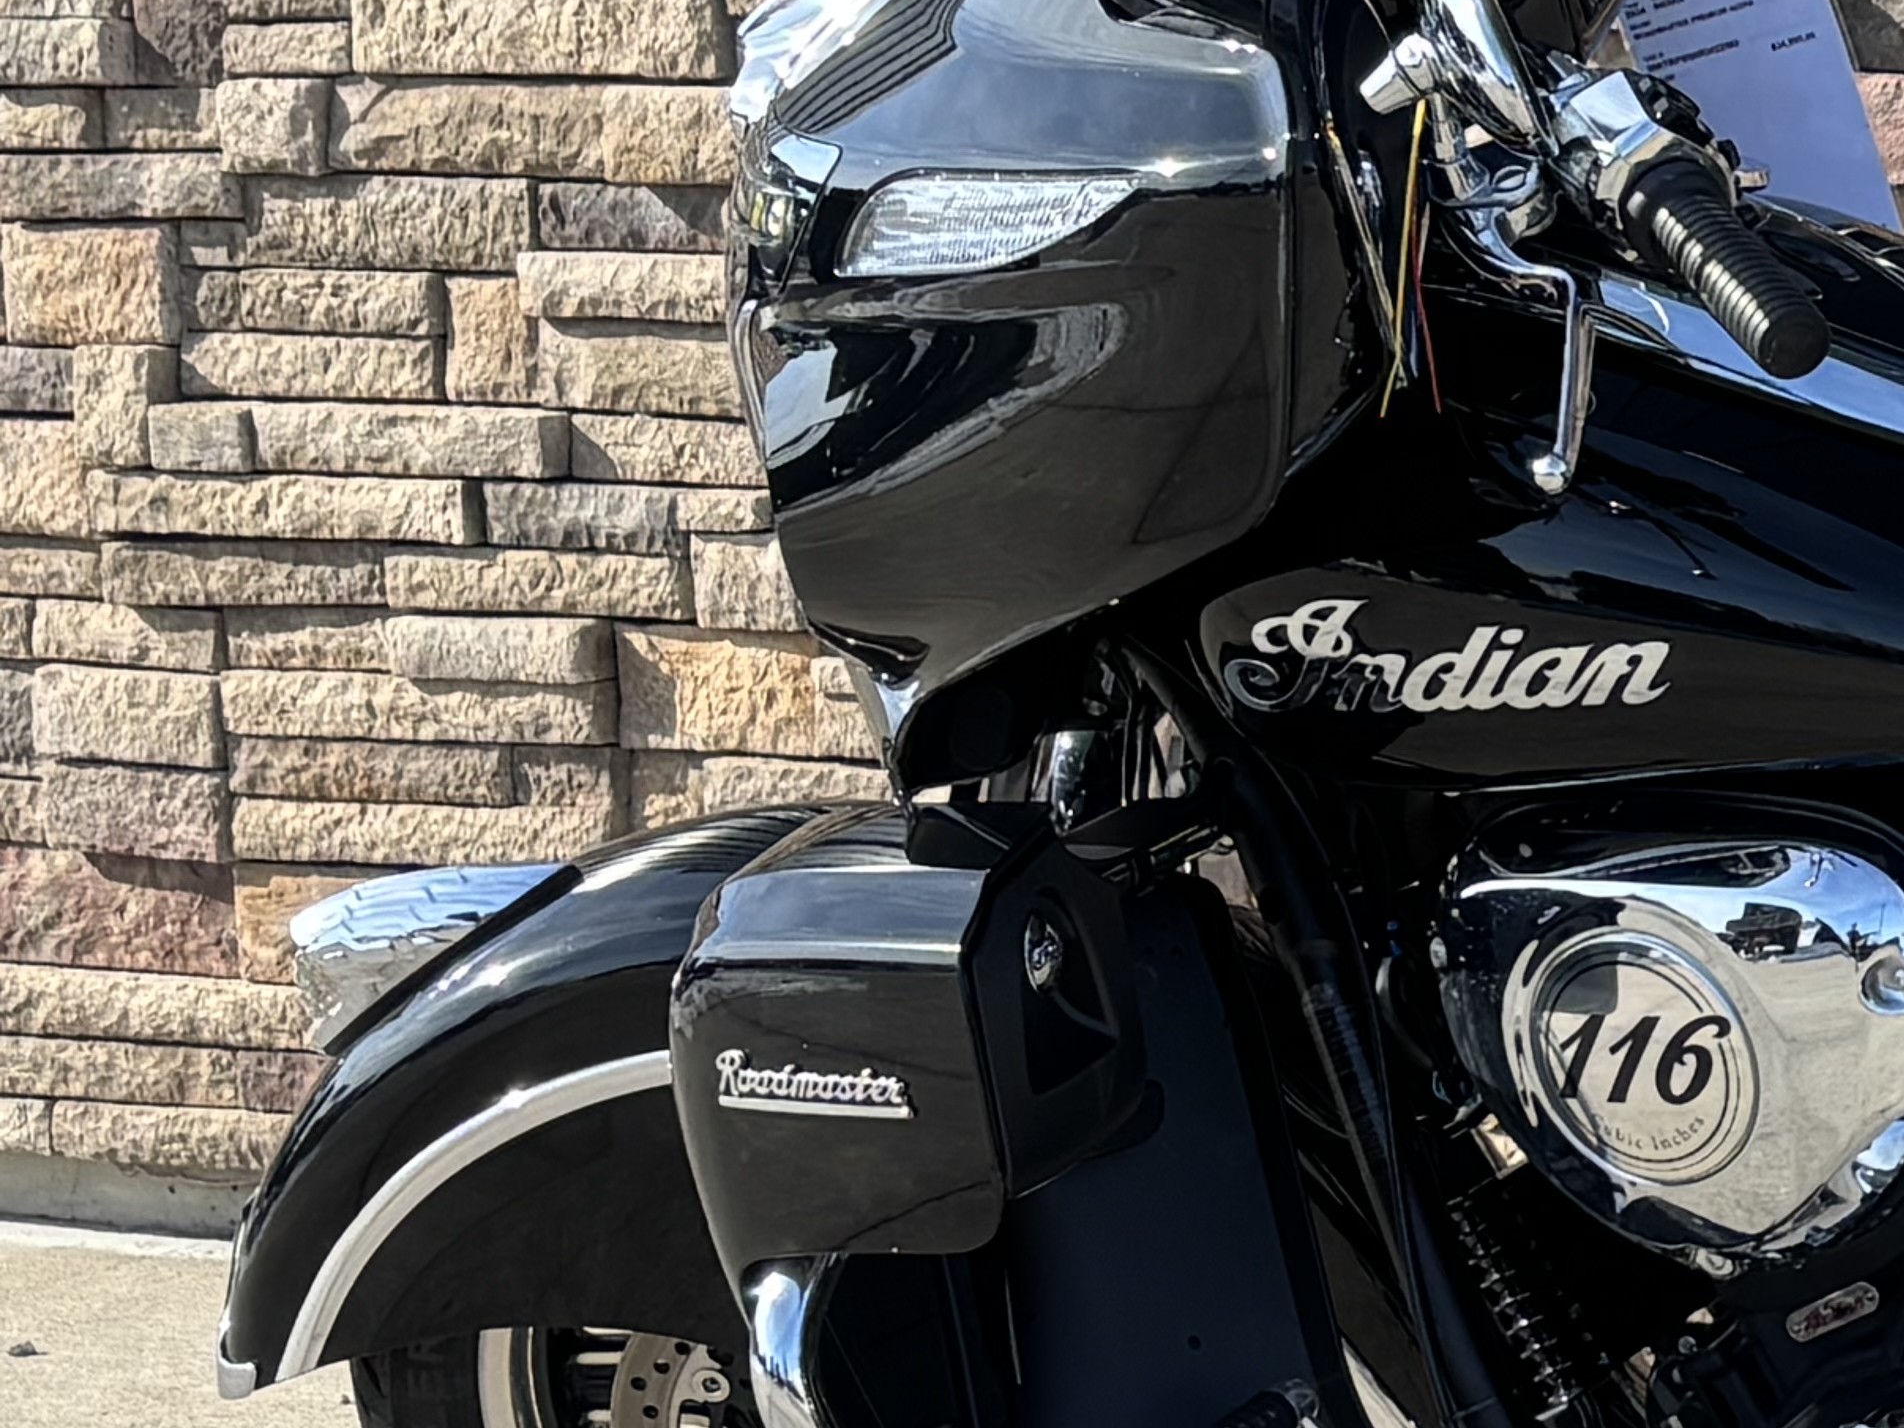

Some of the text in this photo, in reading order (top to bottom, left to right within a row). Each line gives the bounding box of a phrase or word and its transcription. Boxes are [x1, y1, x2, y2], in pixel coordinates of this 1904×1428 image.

[1224, 598, 1671, 713] Indian
[715, 1049, 907, 1105] Roadmaster
[1559, 1014, 1731, 1106] 116
